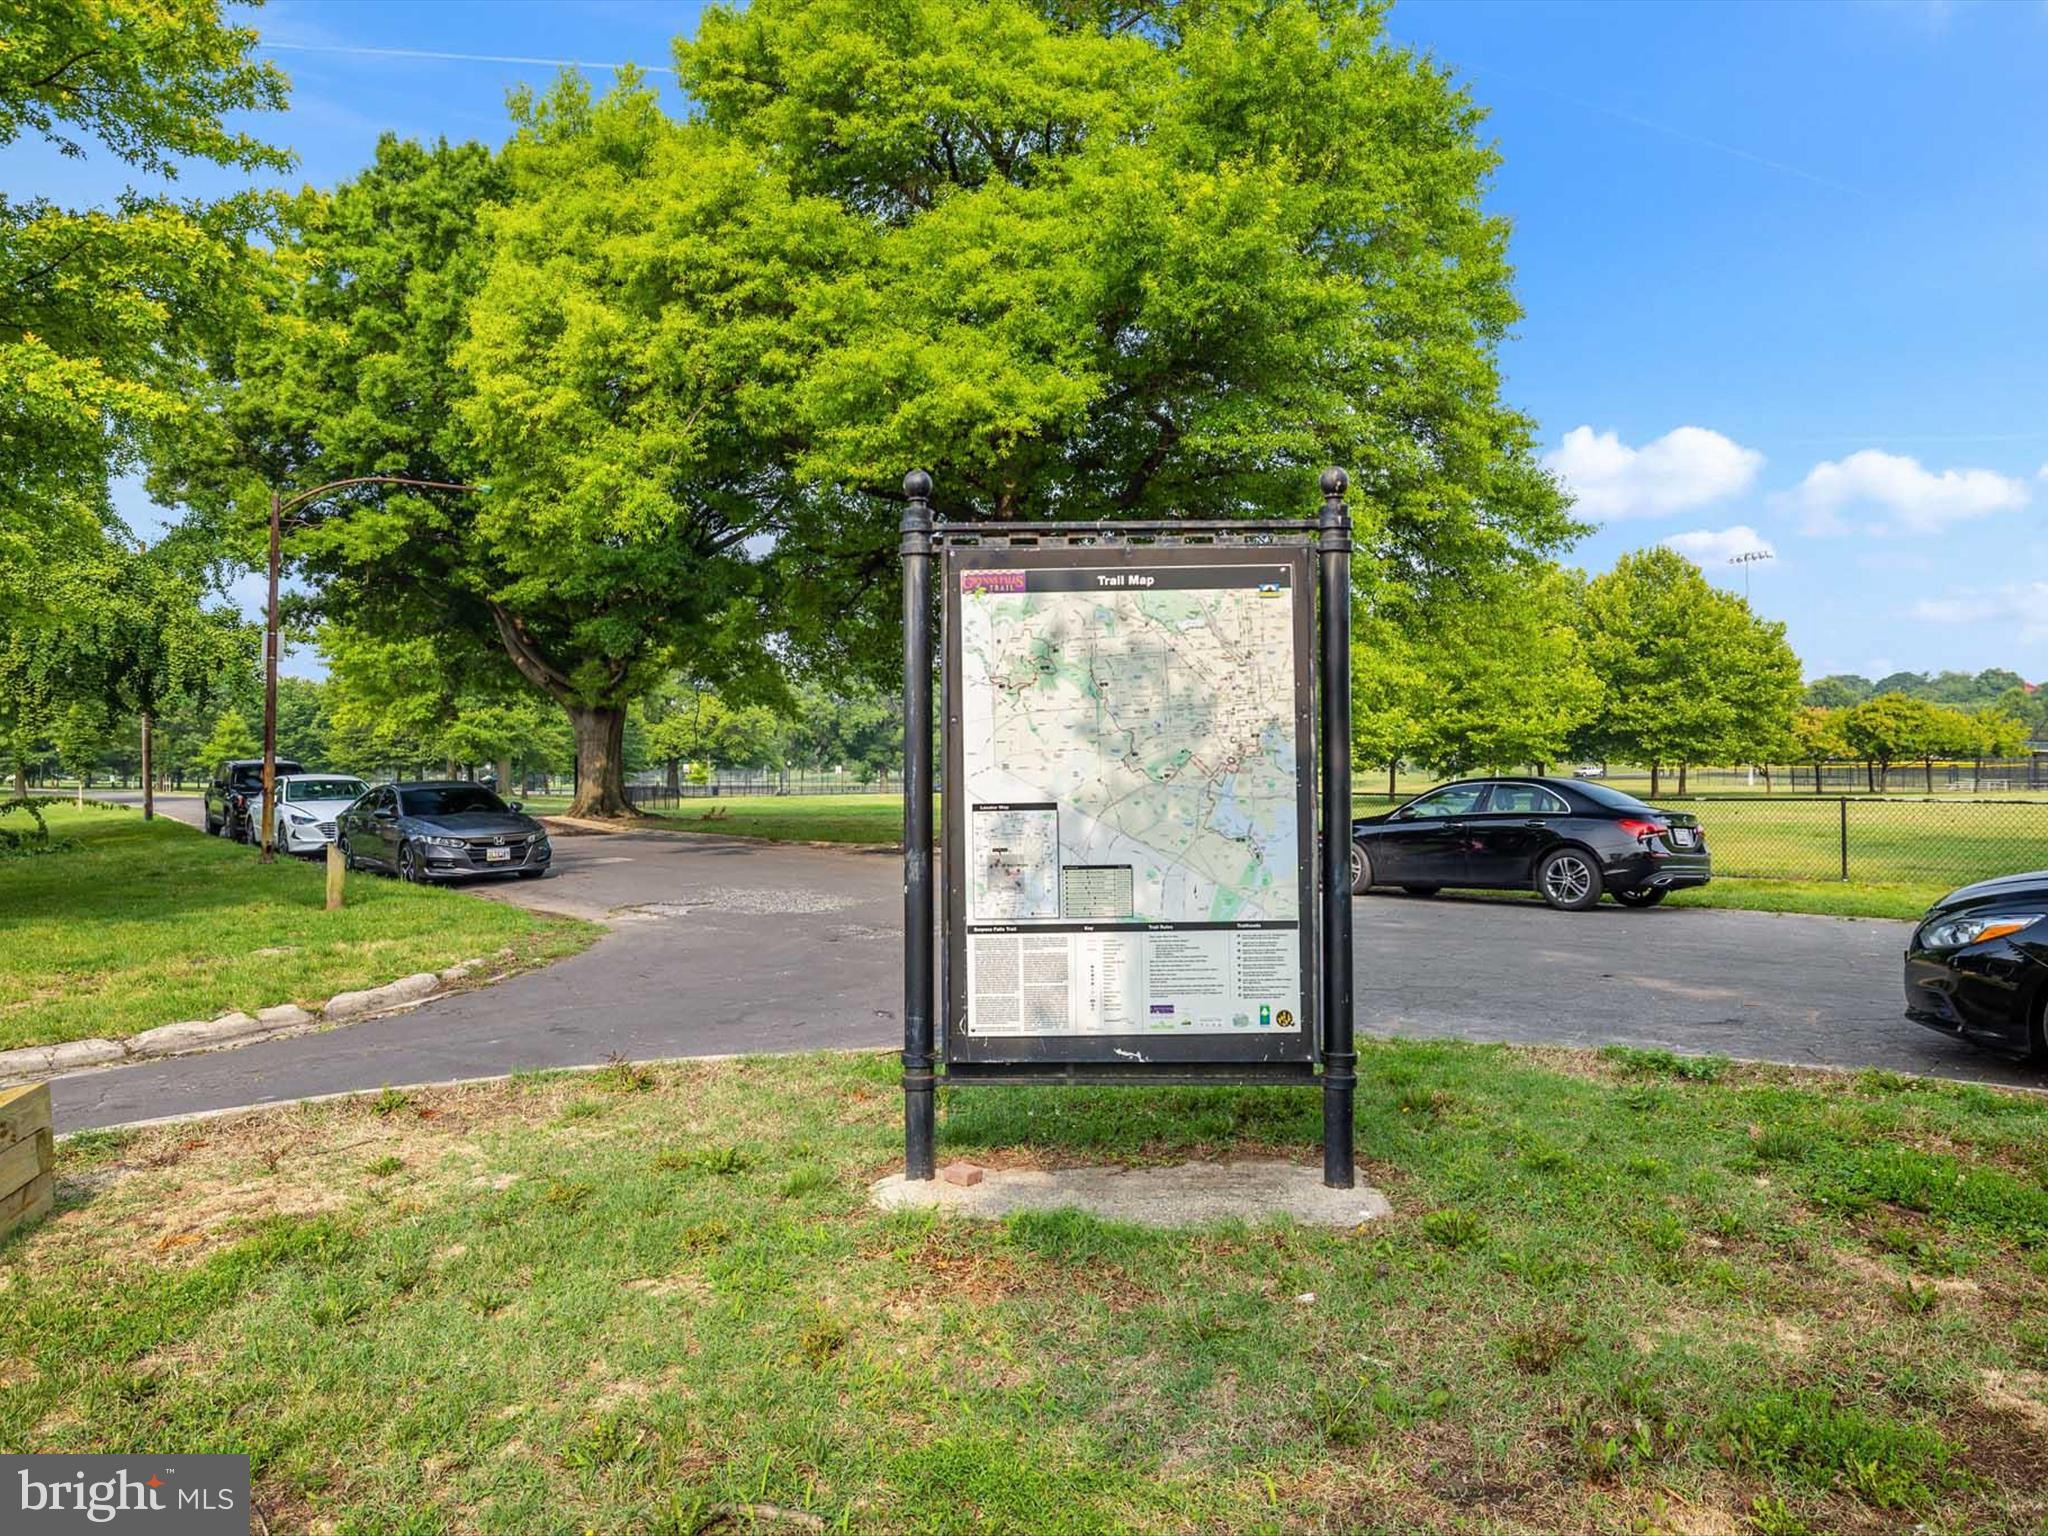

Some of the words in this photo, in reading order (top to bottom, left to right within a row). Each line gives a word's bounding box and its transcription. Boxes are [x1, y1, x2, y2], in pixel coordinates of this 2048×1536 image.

[1097, 575, 1125, 586] Trail
[1128, 574, 1155, 587] Map
[989, 584, 1014, 592] TRAIL
